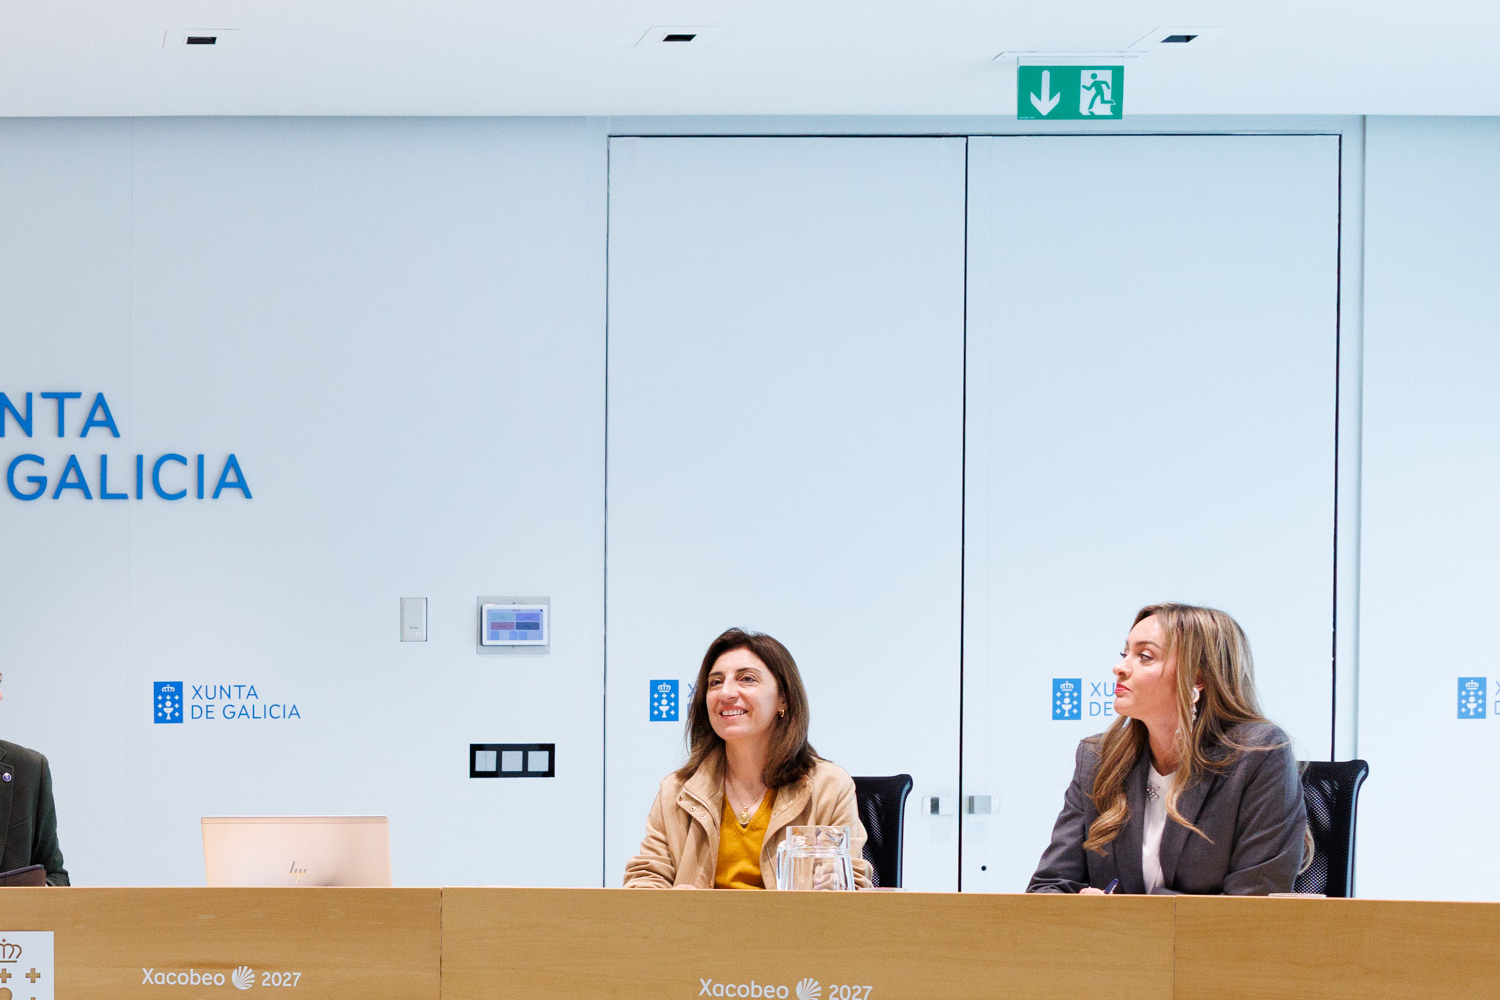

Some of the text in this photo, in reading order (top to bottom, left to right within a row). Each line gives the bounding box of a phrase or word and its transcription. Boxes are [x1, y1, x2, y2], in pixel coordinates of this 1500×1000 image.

[6, 453, 254, 501] GALICIA
[191, 684, 259, 700] XUNTA
[191, 703, 301, 720] DE GALICIA
[1089, 701, 1113, 717] DE
[141, 967, 302, 987] Xacobeo 2027
[698, 978, 789, 1000] Xacobeo
